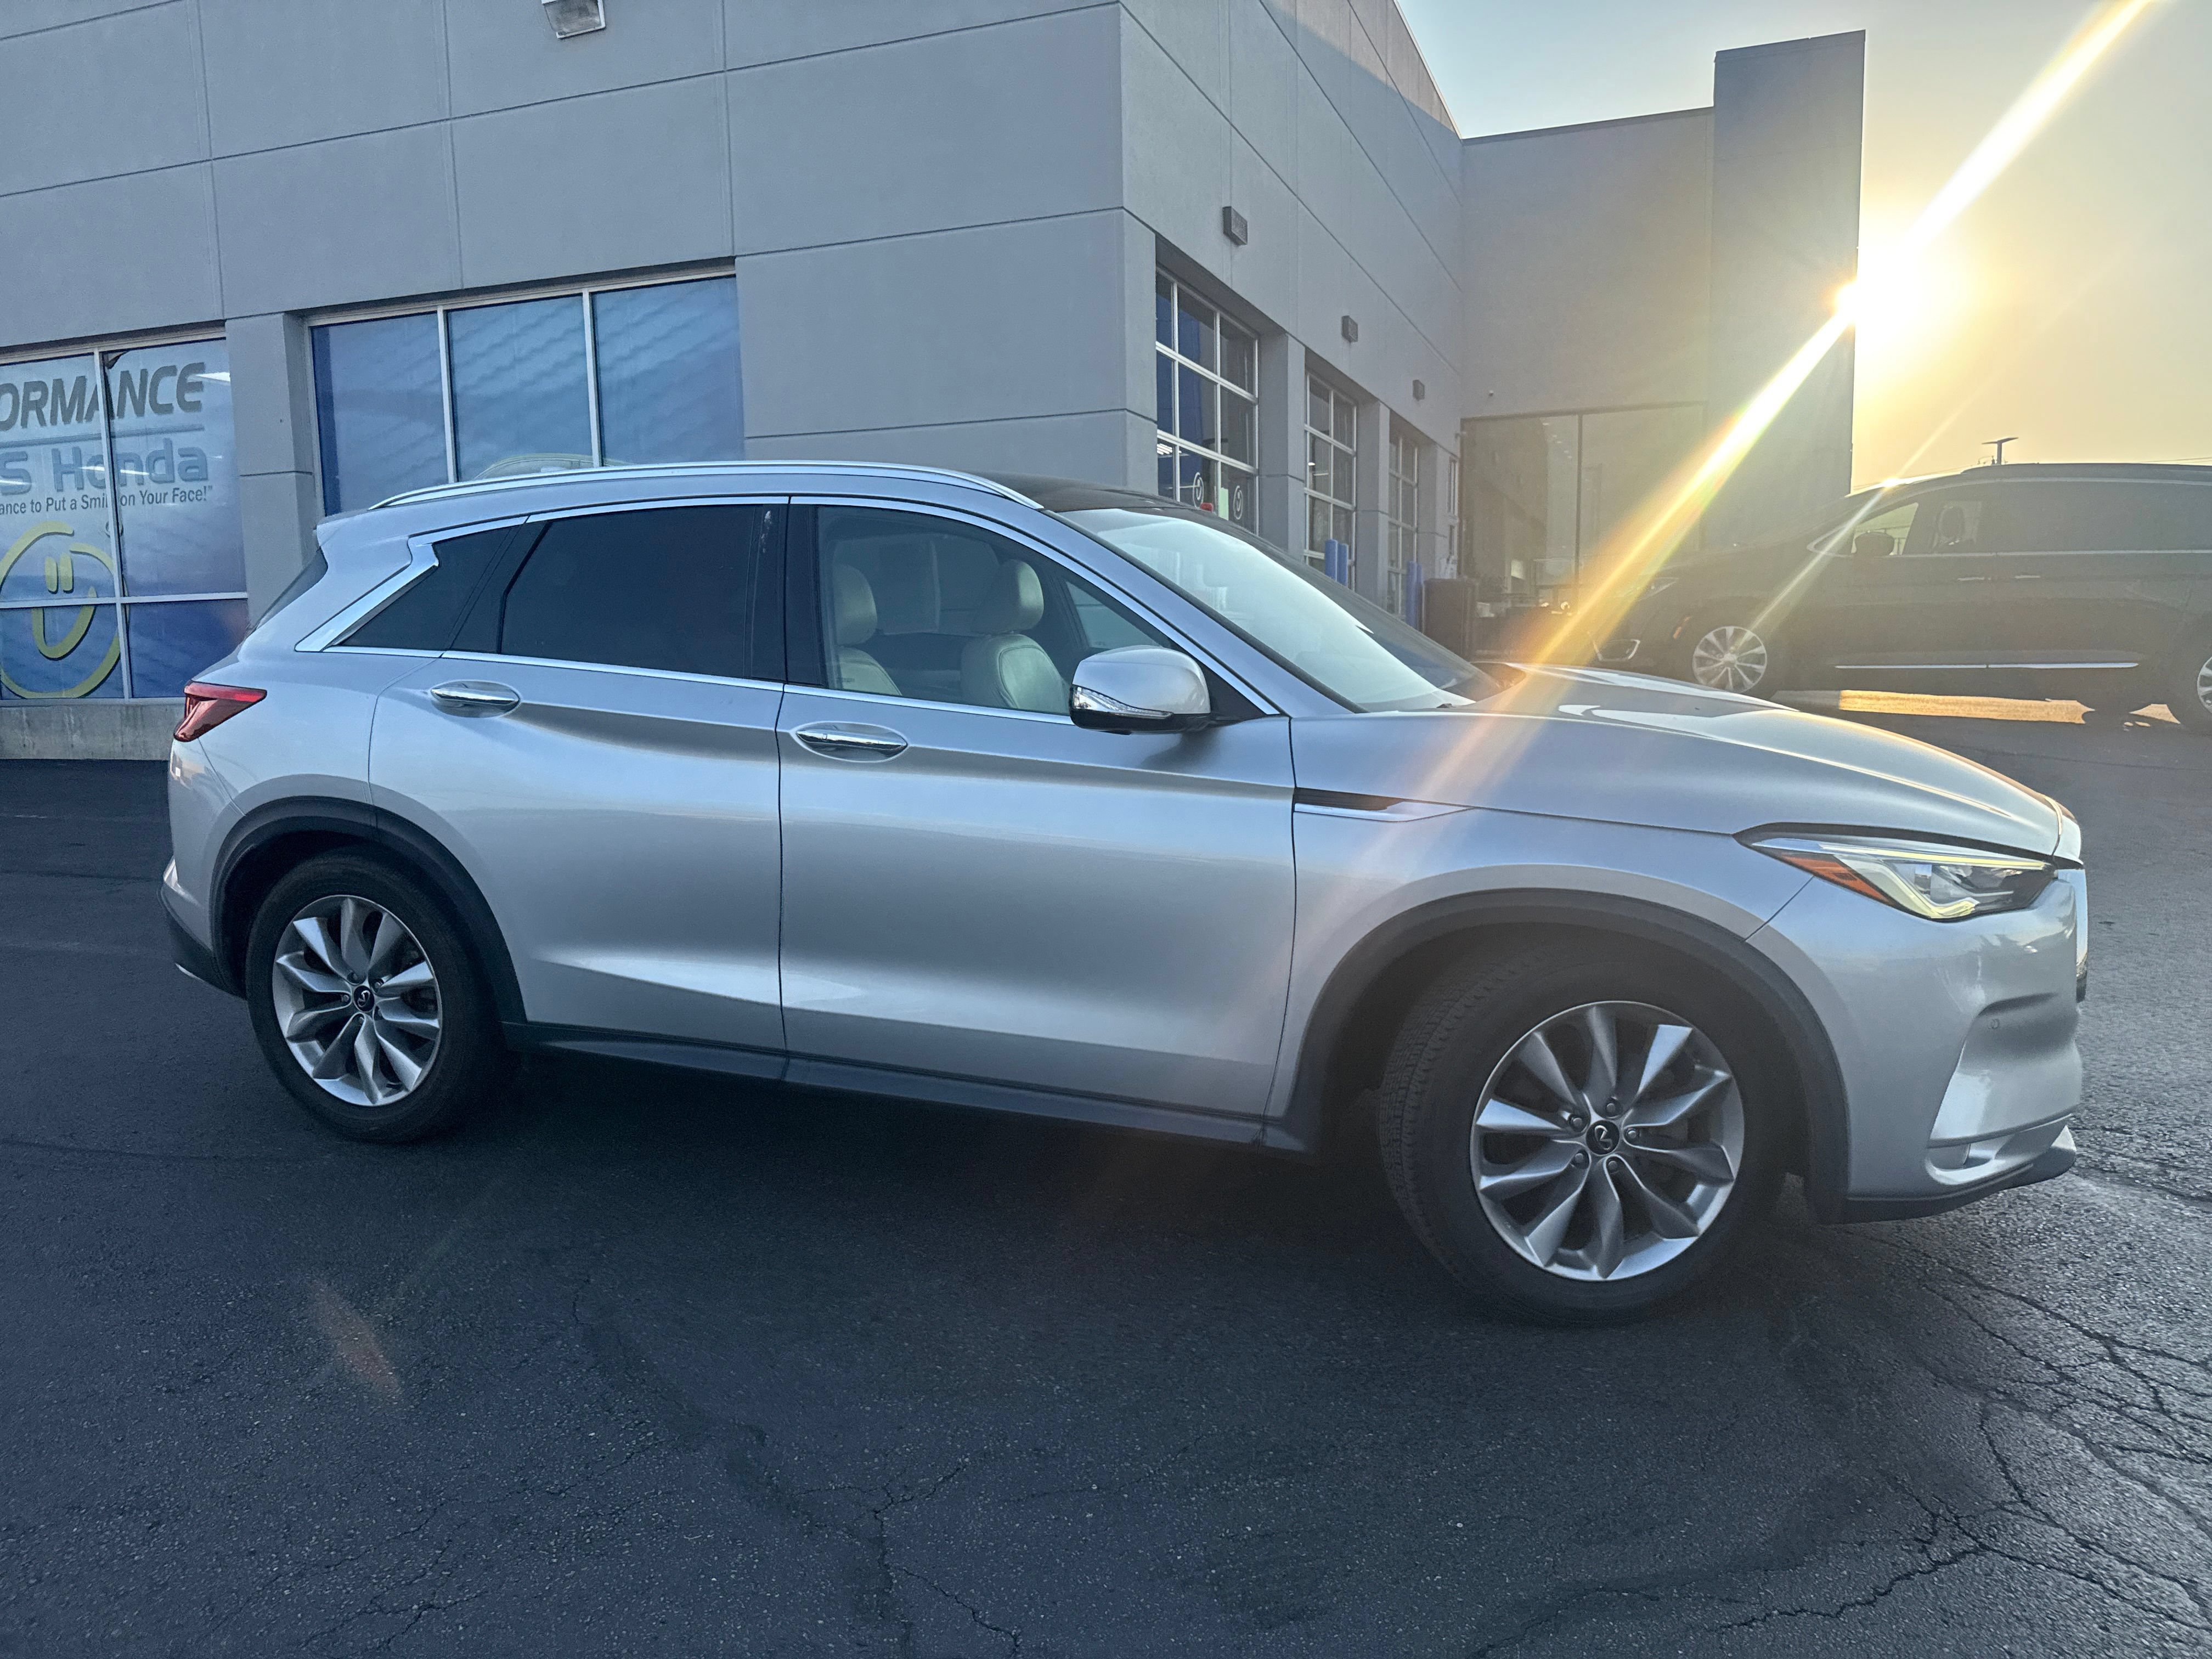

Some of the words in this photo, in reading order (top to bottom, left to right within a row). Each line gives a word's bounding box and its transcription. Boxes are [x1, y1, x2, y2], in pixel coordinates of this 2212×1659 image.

[52, 437, 208, 492] Honda
[31, 499, 42, 513] to
[46, 496, 66, 512] Put
[70, 498, 77, 510] a
[81, 493, 109, 510] Smil
[120, 494, 136, 506] on
[139, 489, 168, 505] Your
